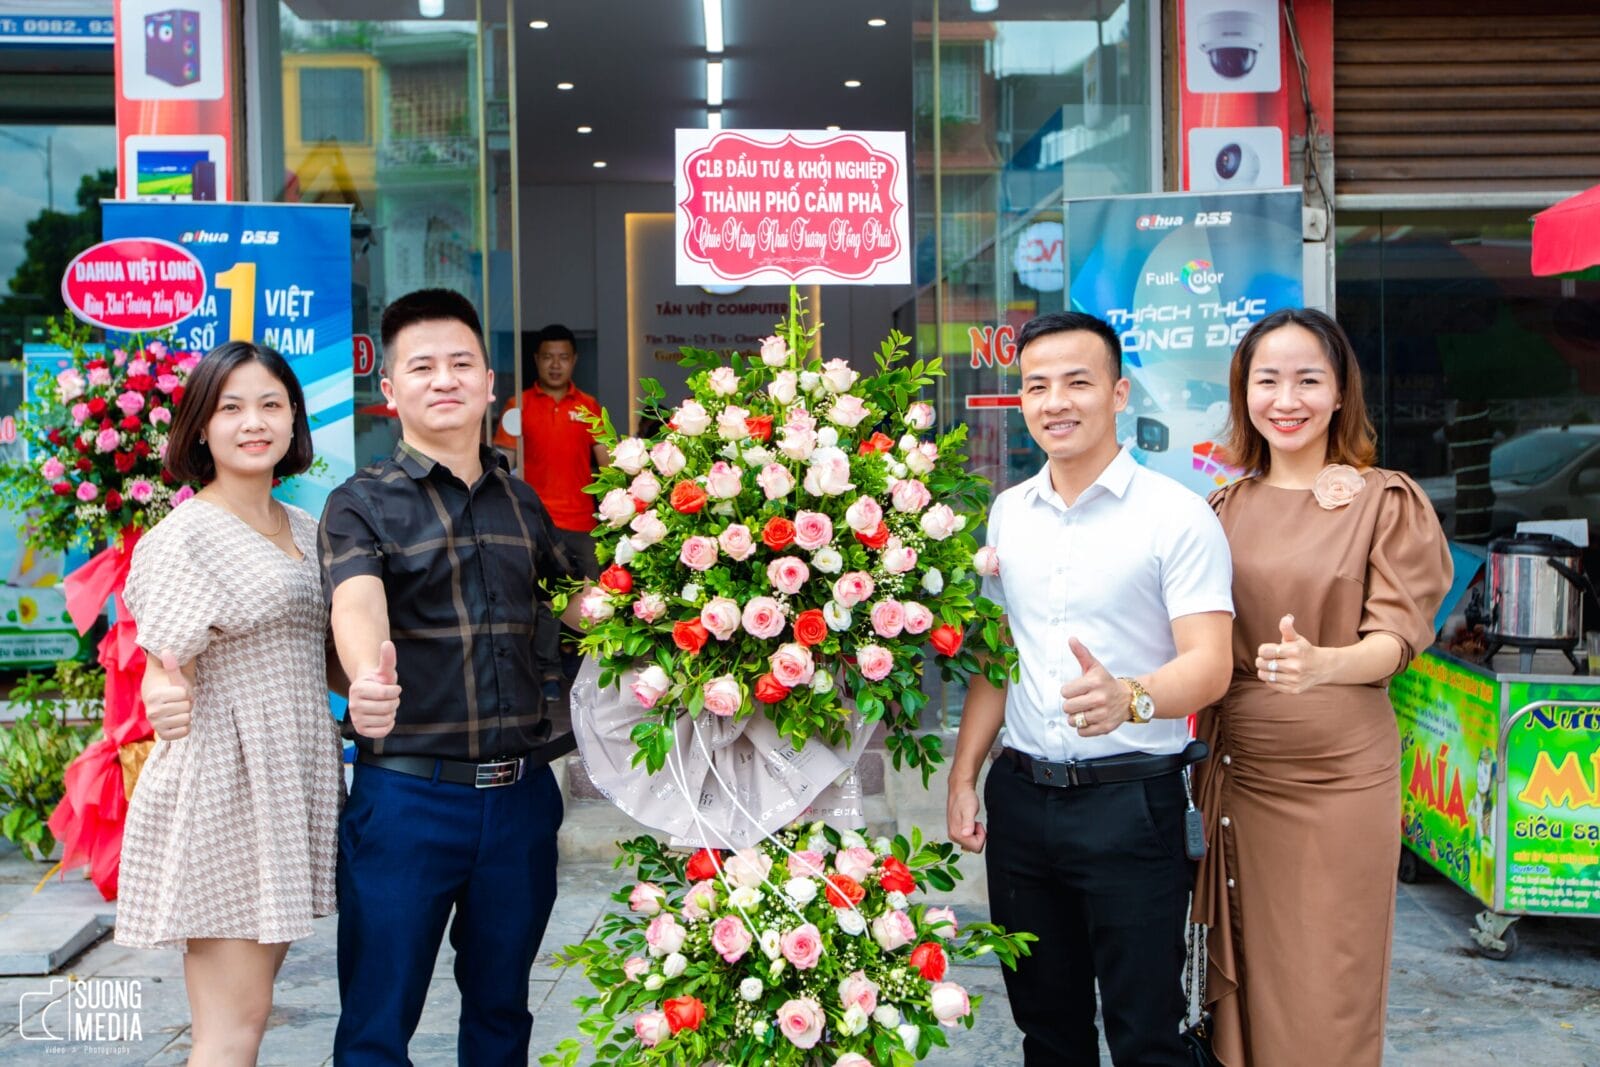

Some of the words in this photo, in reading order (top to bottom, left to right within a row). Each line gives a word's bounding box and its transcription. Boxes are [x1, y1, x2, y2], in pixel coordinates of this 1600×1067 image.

[696, 159, 723, 178] CLB
[726, 153, 757, 178] ĐẦU
[760, 158, 780, 178] TƯ
[784, 160, 795, 178] &
[799, 154, 831, 179] KHỞI
[836, 157, 886, 180] NGHIỆP
[702, 185, 760, 213] THÀNH
[766, 182, 800, 212] PHỐ
[805, 179, 843, 213] CẨM
[848, 180, 883, 213] PHẢ
[1194, 211, 1232, 227] DSS
[240, 230, 280, 245] DSS
[693, 216, 721, 256] Chúc
[722, 216, 756, 259] Mừng
[757, 217, 789, 253] Khai
[790, 217, 828, 259] Trương
[828, 218, 861, 257] Hồng
[862, 217, 891, 252] Phát
[75, 260, 125, 282] DAHUA
[126, 257, 157, 285] VIỆT
[159, 260, 197, 281] LONG
[215, 262, 256, 343] 1
[265, 285, 315, 323] VIỆT
[656, 301, 682, 316] TÂN
[687, 301, 713, 318] VIỆT
[716, 302, 788, 316] COMPUTER
[1106, 302, 1191, 325] THÁCH
[1198, 297, 1266, 319] THÚC
[190, 321, 219, 351] SỐ
[264, 327, 315, 355] NAM
[968, 325, 1019, 369] NG
[1408, 742, 1470, 832] MÍA
[1515, 815, 1562, 840] siêu
